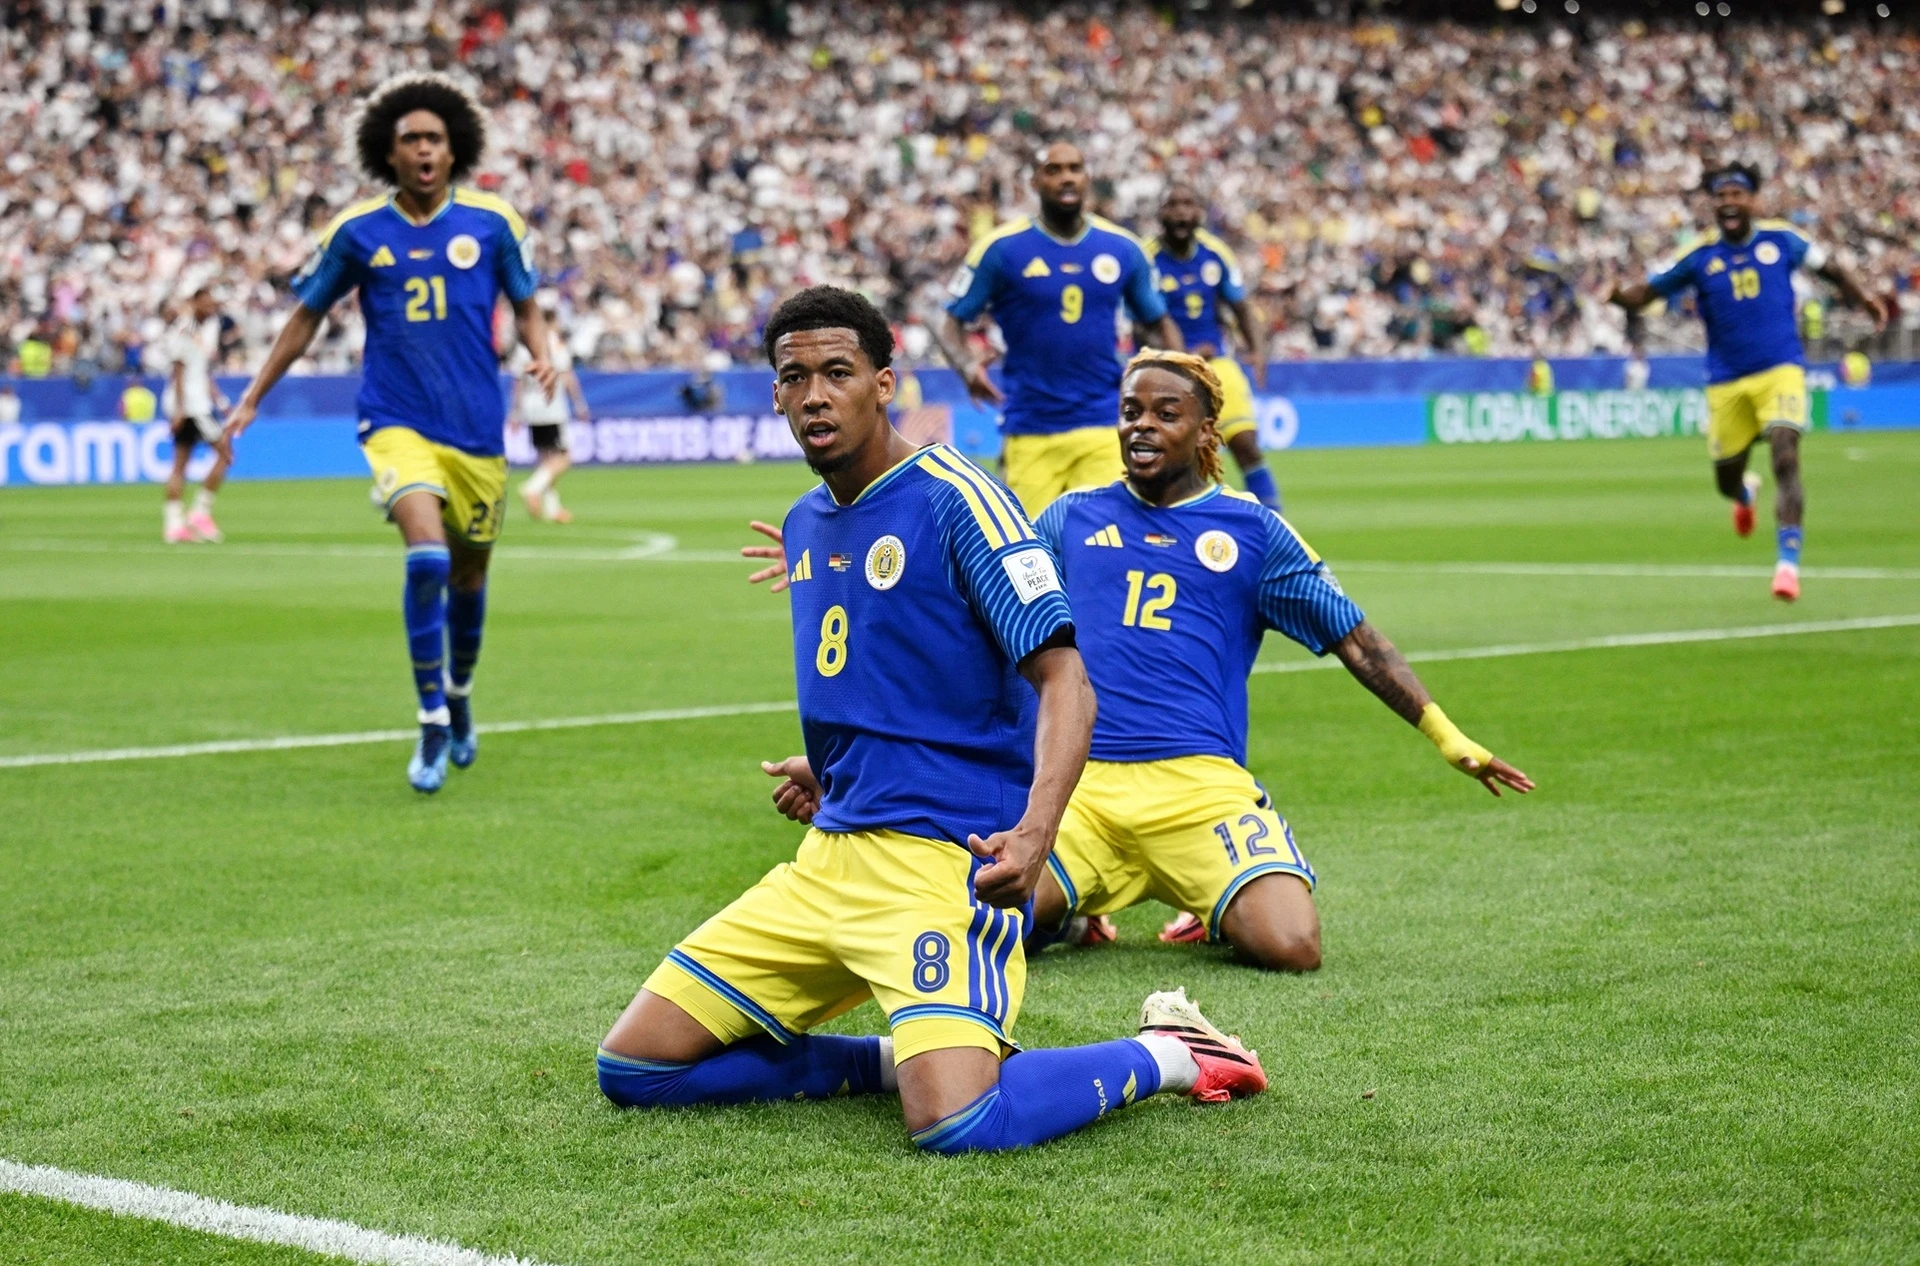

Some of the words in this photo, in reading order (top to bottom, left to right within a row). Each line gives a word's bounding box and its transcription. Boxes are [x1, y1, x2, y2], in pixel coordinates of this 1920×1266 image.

[403, 275, 447, 322] 21
[1060, 284, 1084, 324] 9
[1729, 266, 1761, 301] 10
[597, 415, 709, 463] STATES
[1434, 391, 1557, 443] GLOBAL
[1557, 389, 1679, 440] ENERGY
[1027, 573, 1050, 588] PEACE
[1122, 569, 1177, 632] 12
[816, 604, 849, 678] 8
[1213, 813, 1277, 867] 12
[912, 930, 951, 994] 8
